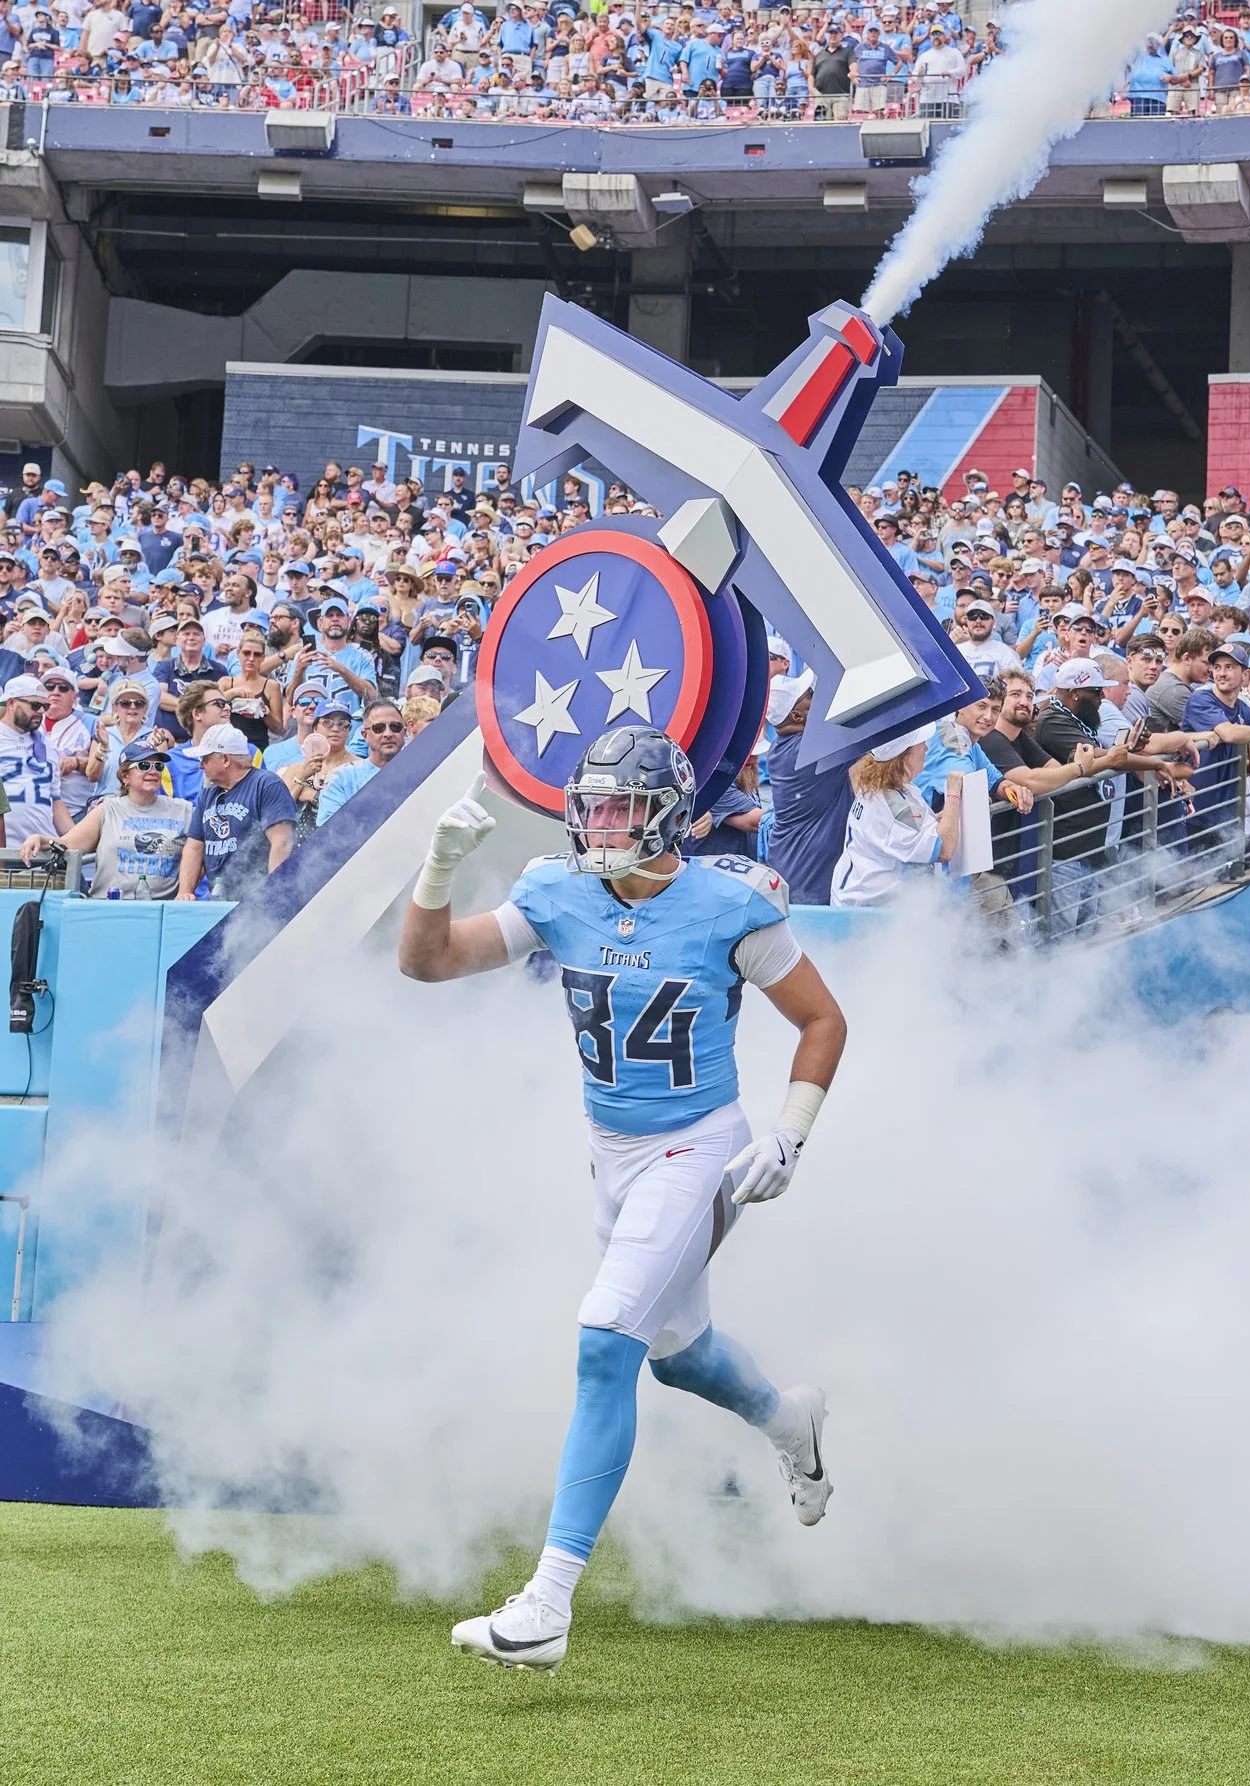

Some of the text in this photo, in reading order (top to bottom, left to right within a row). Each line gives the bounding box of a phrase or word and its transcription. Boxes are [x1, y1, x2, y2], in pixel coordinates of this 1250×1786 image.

[420, 438, 516, 457] TENNES
[600, 945, 652, 970] TITANS
[560, 965, 703, 1091] 84
